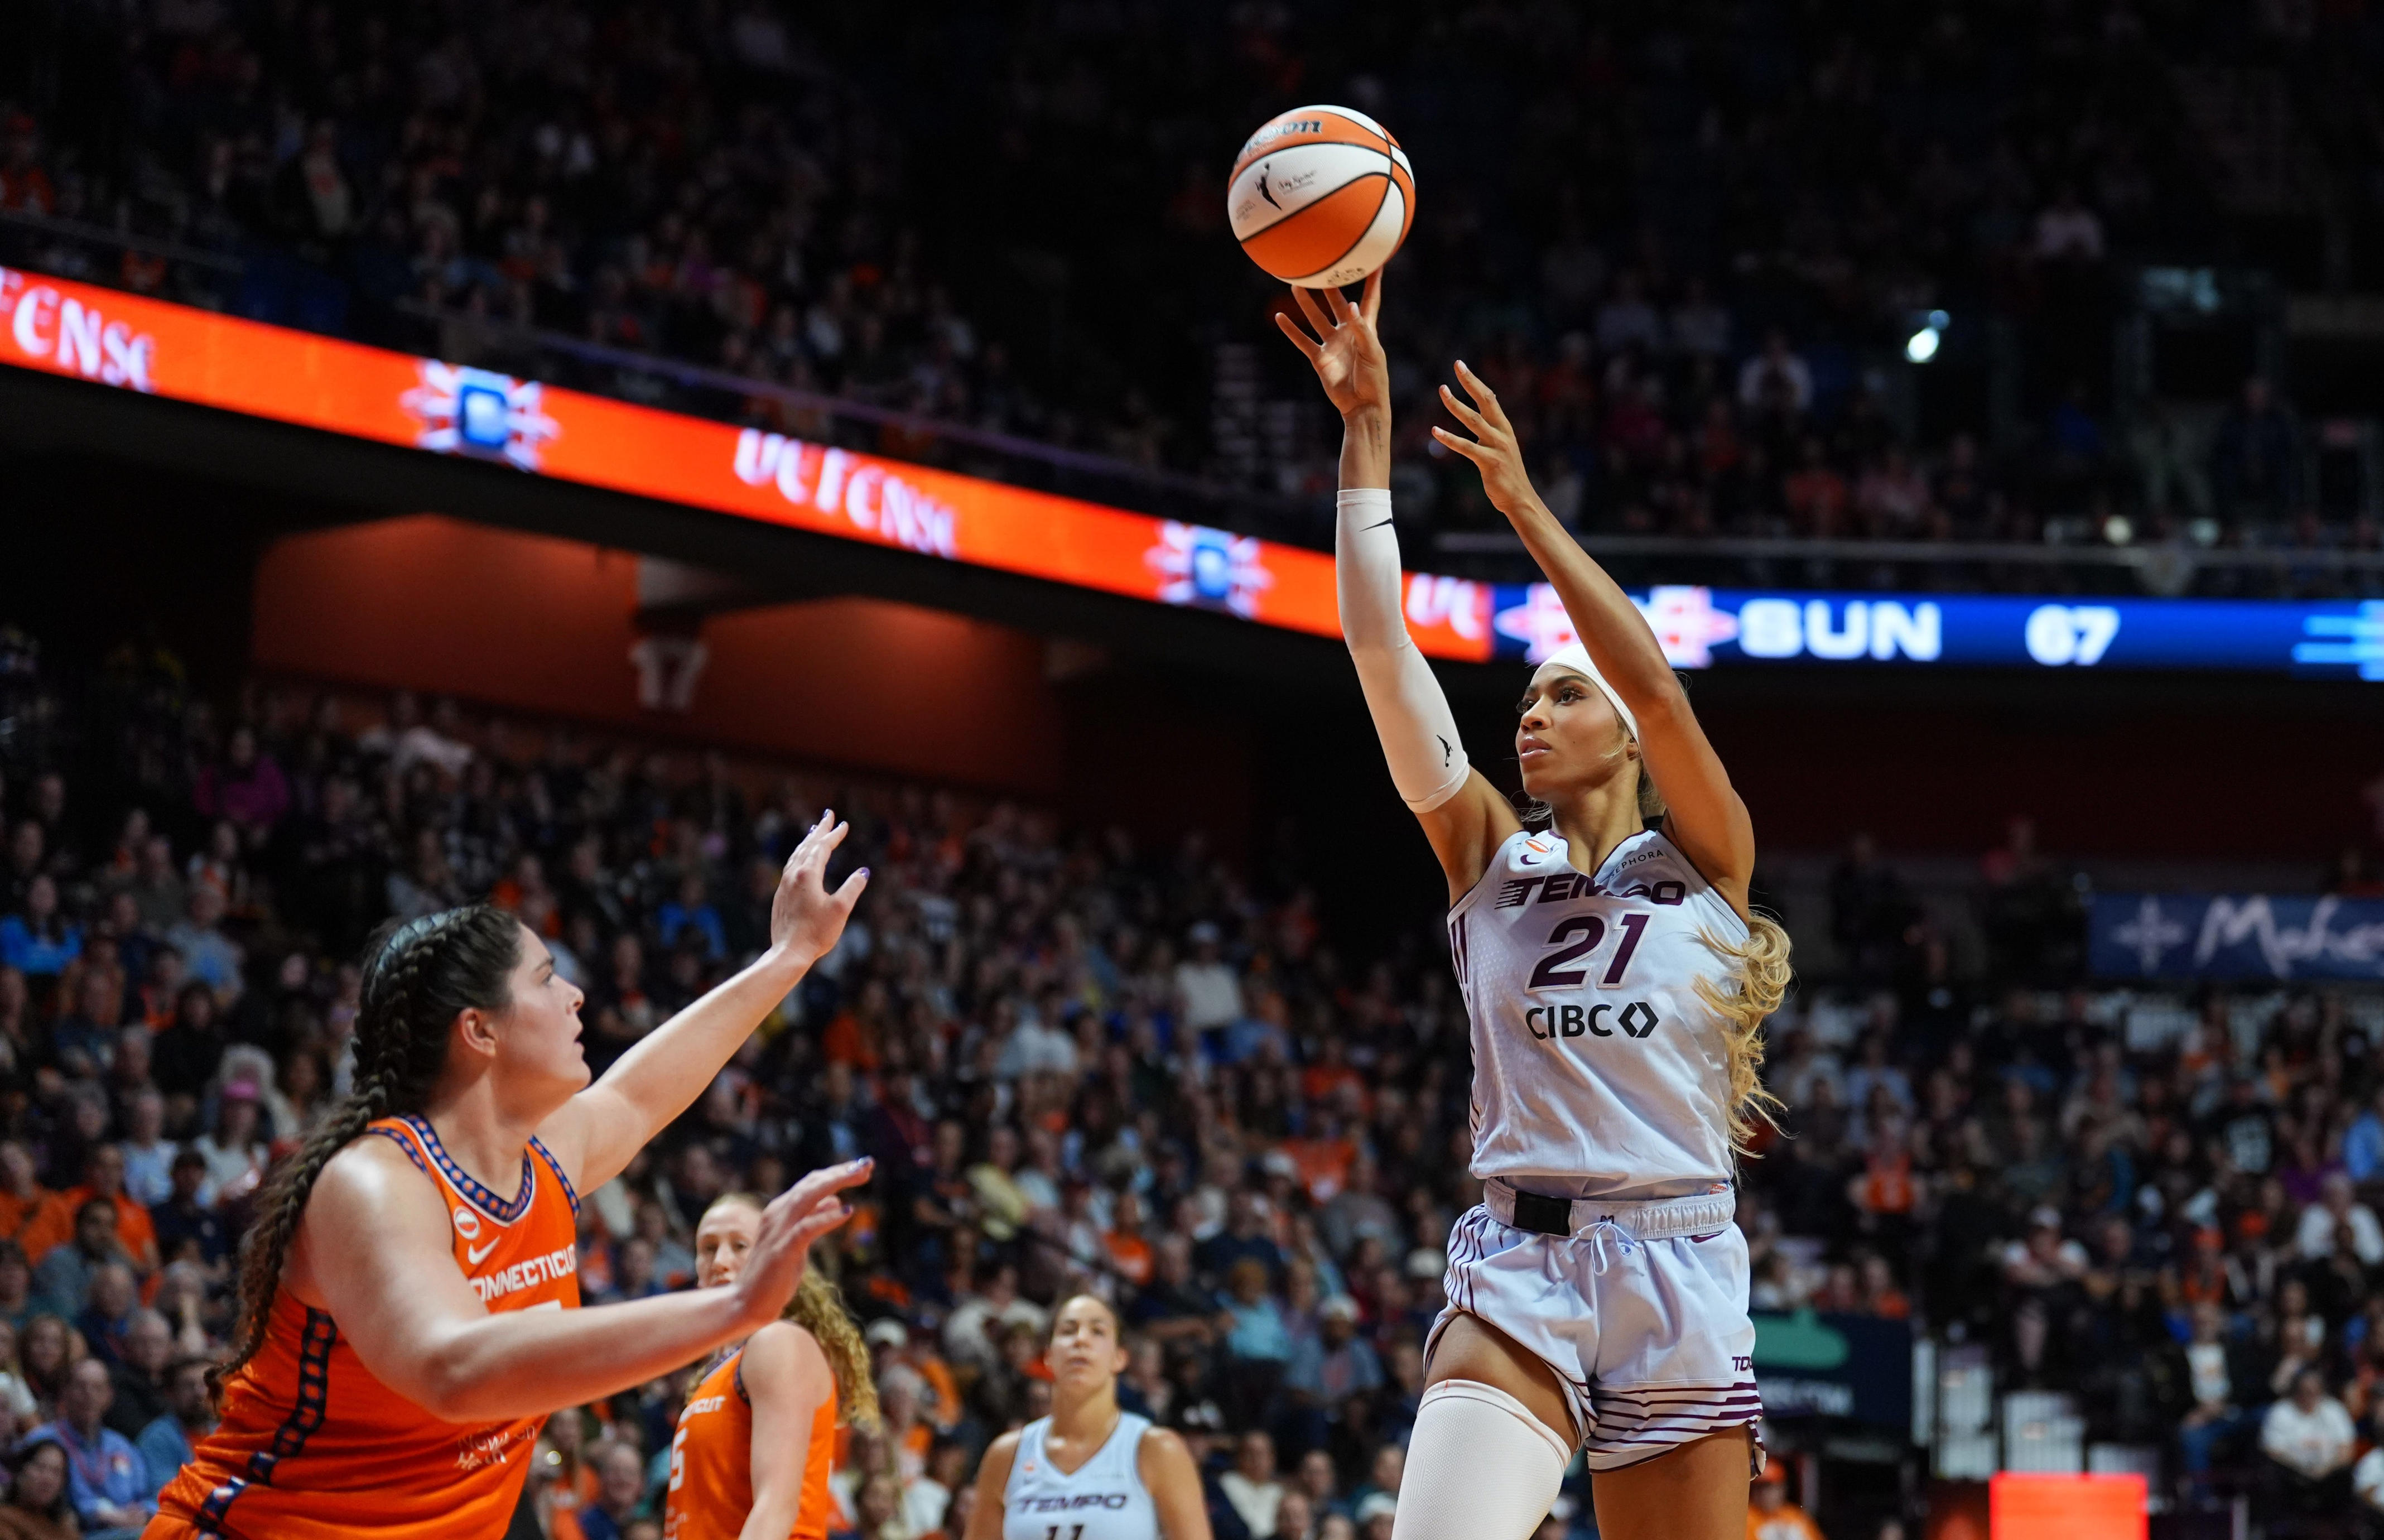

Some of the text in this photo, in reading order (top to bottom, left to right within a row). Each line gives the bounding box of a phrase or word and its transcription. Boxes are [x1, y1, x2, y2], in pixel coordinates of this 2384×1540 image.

[1738, 598, 1943, 662] SUN
[1525, 909, 1656, 994] 21
[1525, 1004, 1612, 1040] CIBC
[1732, 1356, 1753, 1371] TO
[1017, 1494, 1127, 1514] TEMPO
